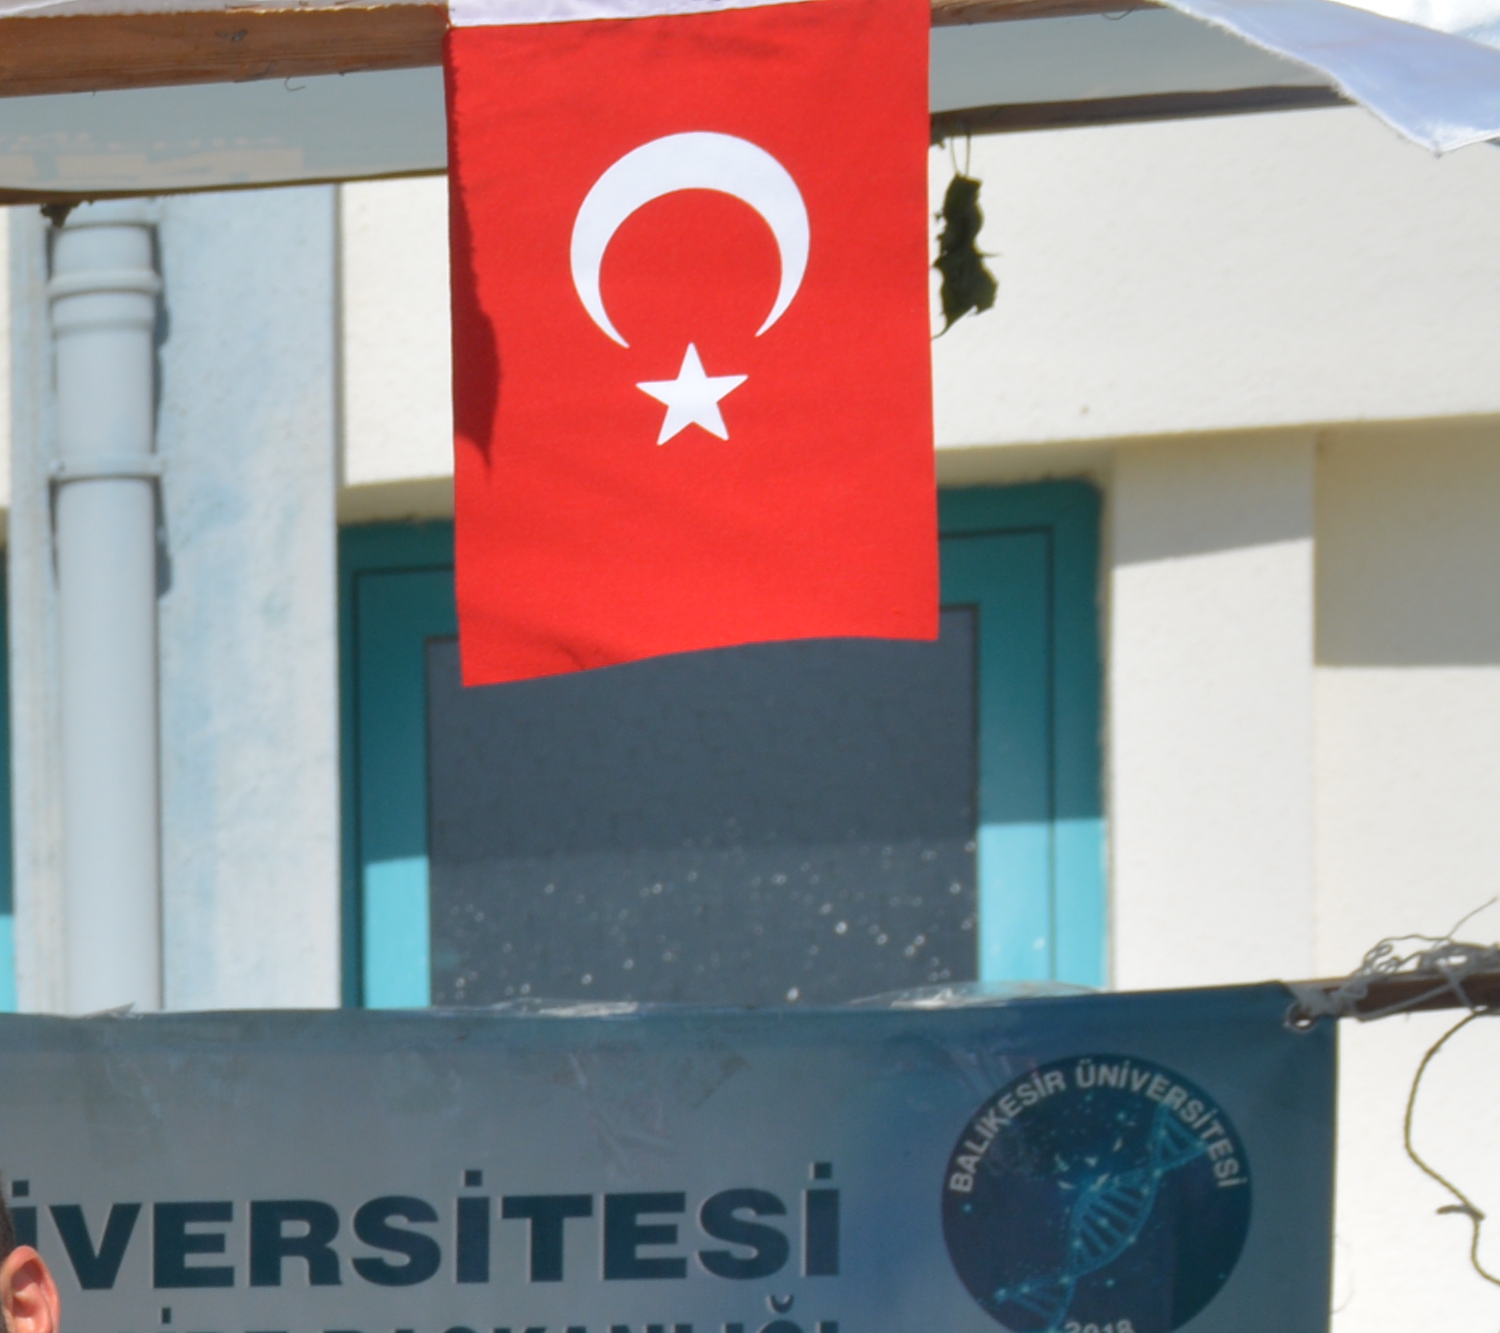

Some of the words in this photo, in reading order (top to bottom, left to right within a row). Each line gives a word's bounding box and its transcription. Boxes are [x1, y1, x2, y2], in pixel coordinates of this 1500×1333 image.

[950, 1070, 1067, 1193] BALIKESİR
[1074, 1058, 1248, 1188] ÜNİVERSİTESİ
[11, 1161, 842, 1291] İVERSİTESİ
